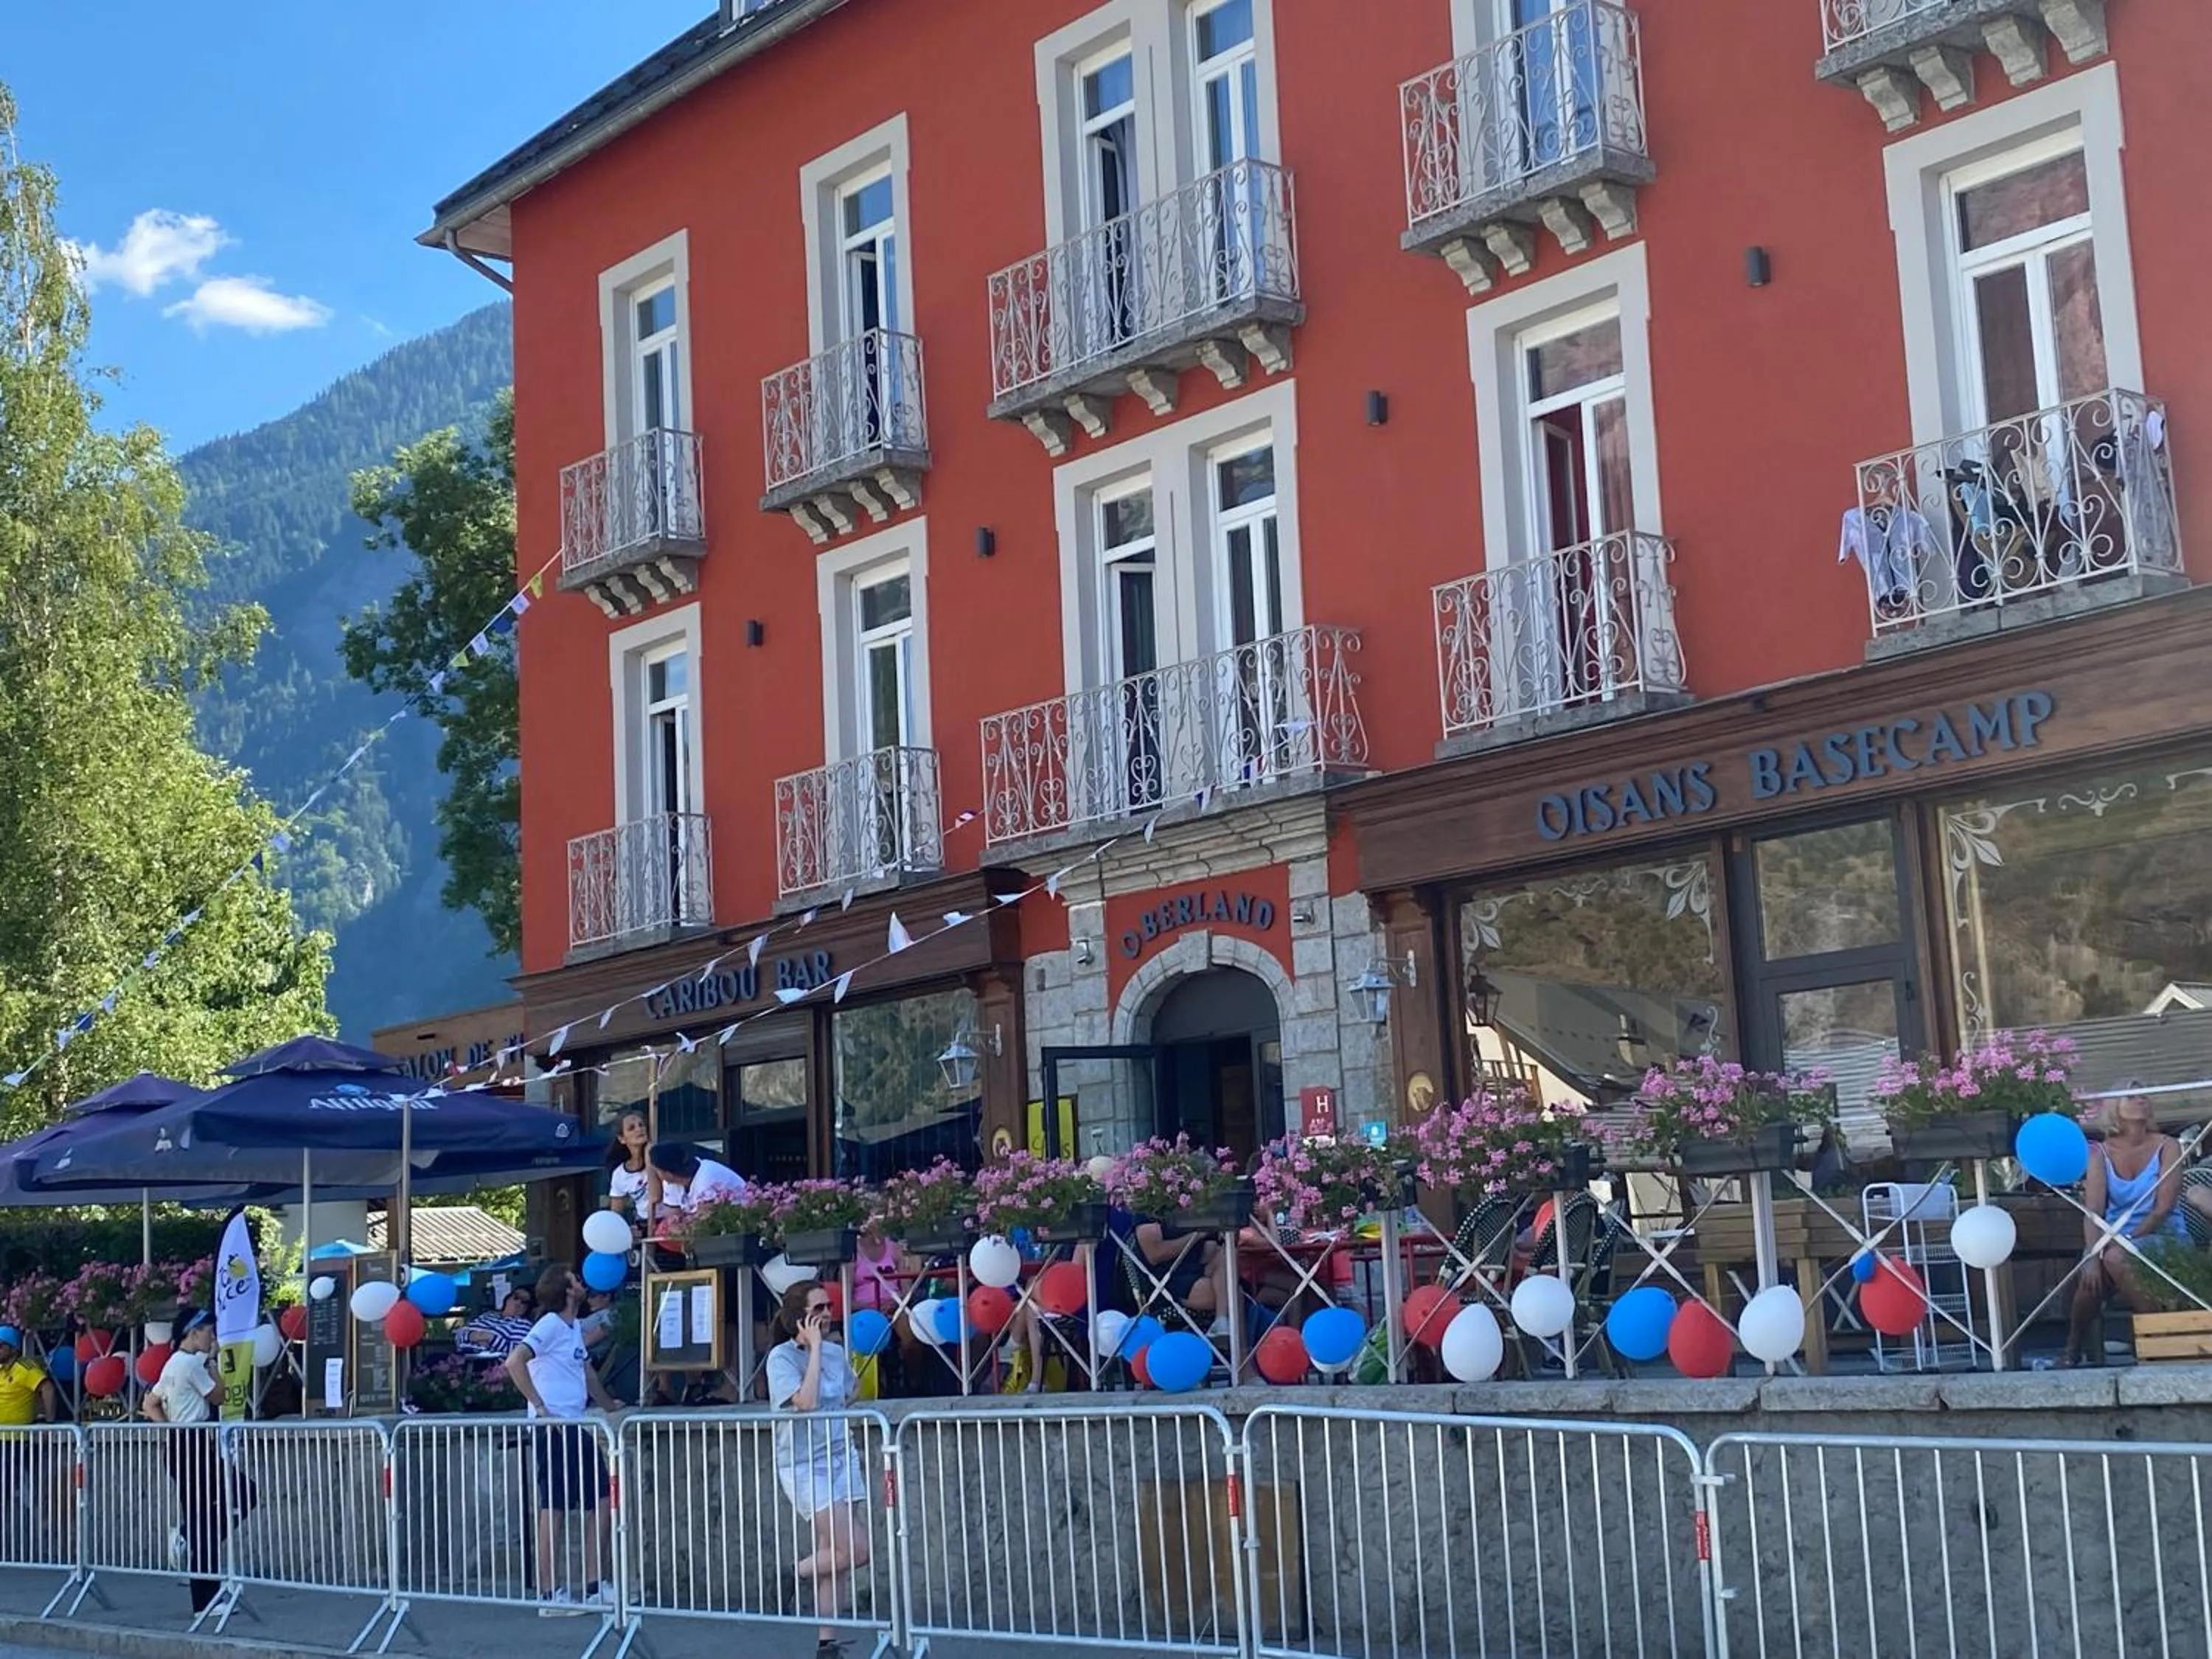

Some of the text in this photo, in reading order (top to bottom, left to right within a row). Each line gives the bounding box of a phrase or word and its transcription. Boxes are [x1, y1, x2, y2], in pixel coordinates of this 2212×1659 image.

[1536, 689, 2053, 841] OISANS BASECAMP
[1120, 890, 1274, 959] OBERLAND
[777, 950, 830, 991] BAR
